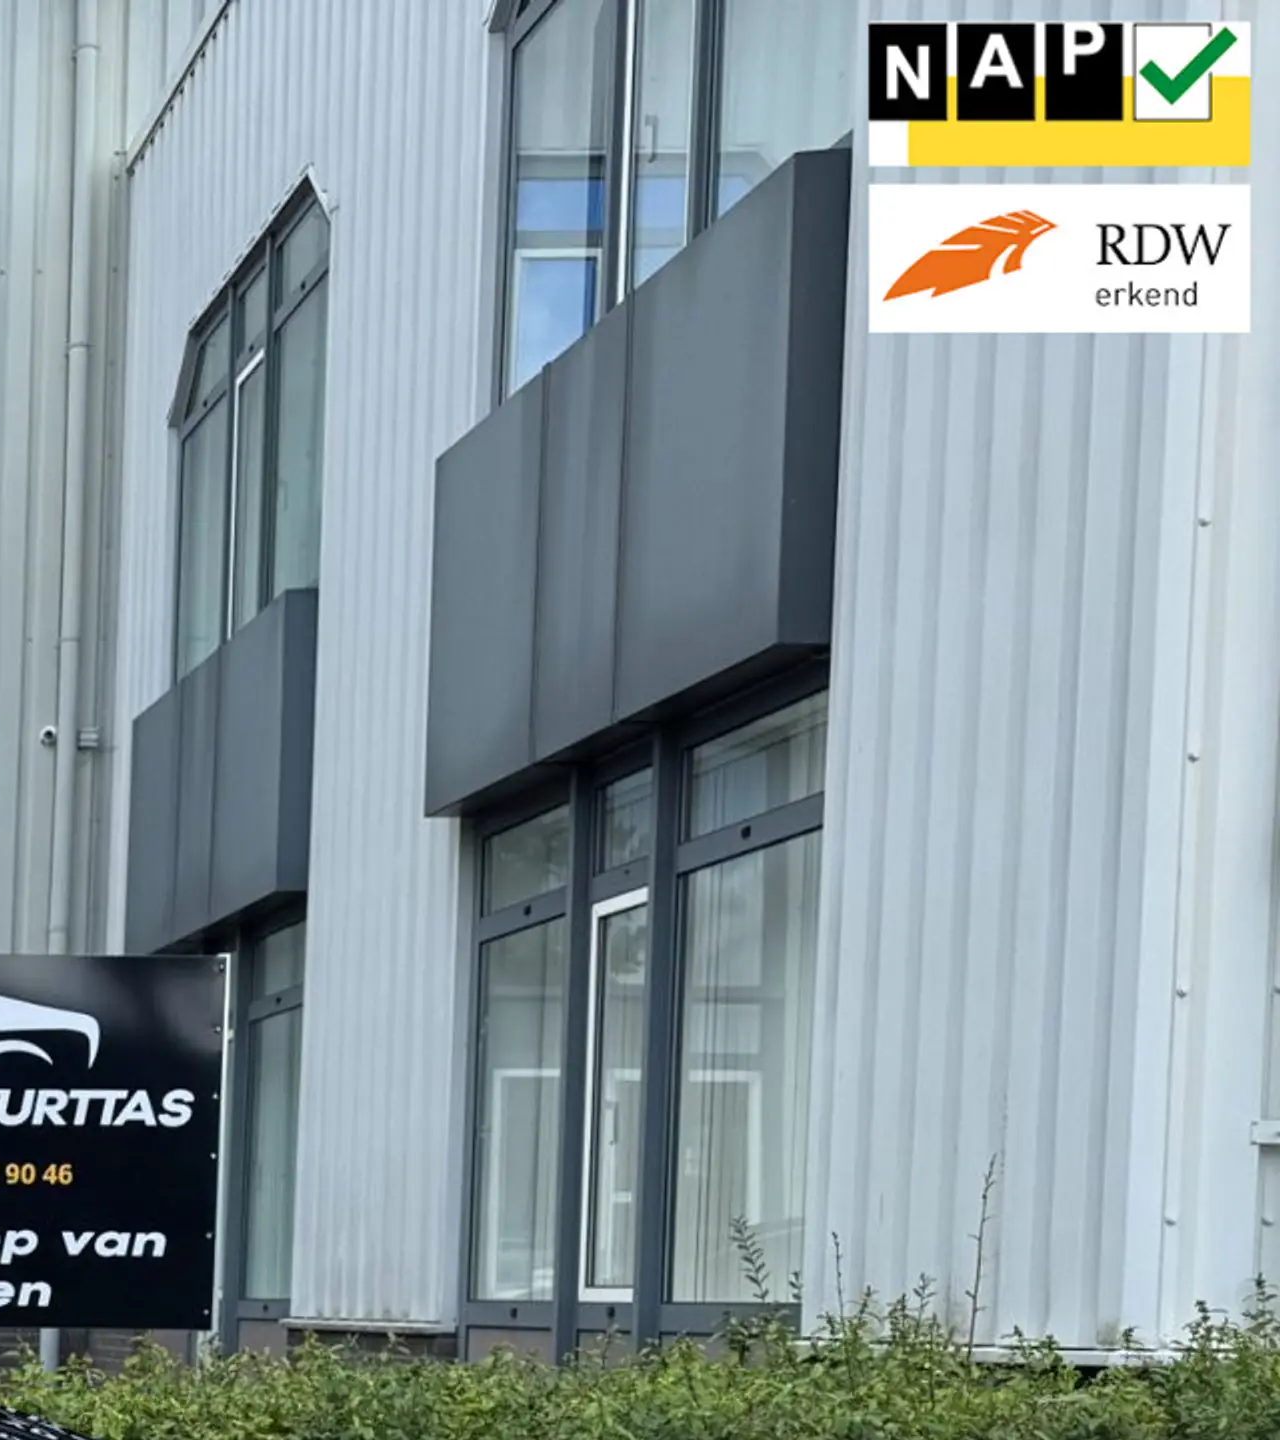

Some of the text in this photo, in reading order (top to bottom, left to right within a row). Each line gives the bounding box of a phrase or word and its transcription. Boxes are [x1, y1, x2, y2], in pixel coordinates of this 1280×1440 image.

[6, 1163, 37, 1185] 90
[41, 1163, 73, 1186] 46
[62, 1229, 167, 1258] van
